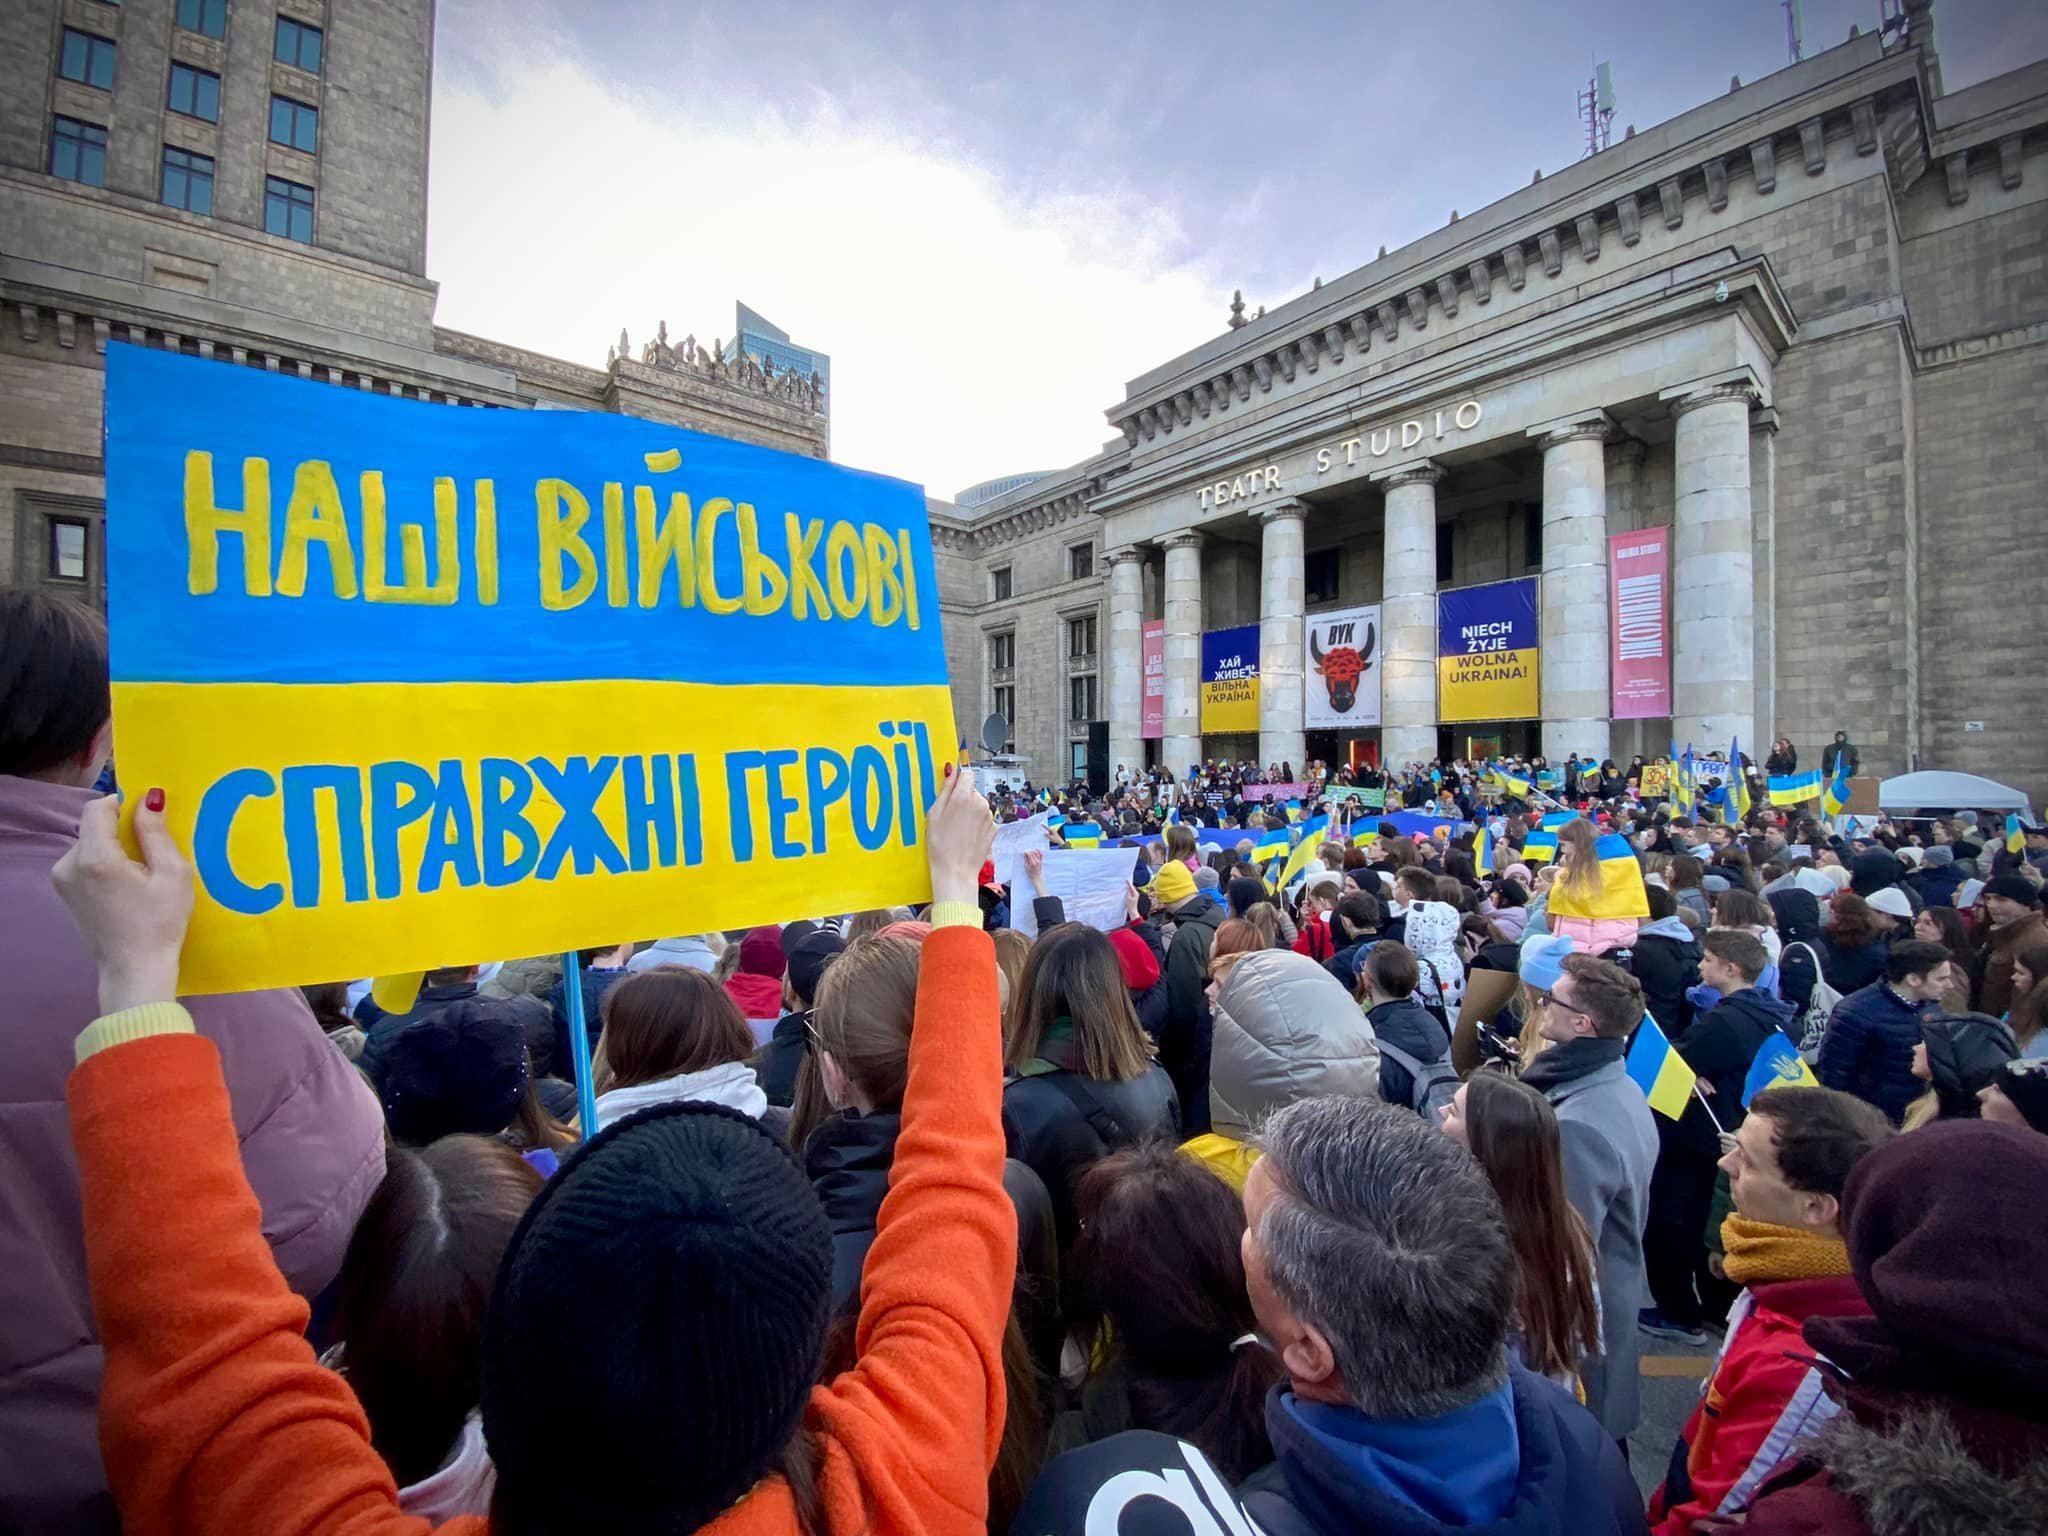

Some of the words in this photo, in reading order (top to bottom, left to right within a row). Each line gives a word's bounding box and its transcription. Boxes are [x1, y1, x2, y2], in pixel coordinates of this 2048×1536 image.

[1196, 465, 1282, 511] TEATR
[1316, 400, 1484, 474] STUDIO
[184, 449, 498, 606] НАШІ
[535, 448, 922, 631] ВІЙСЬКОВІ
[1328, 622, 1356, 646] BYK
[1461, 620, 1512, 639] NIECH
[1467, 637, 1507, 654] ŻYJE
[1219, 655, 1241, 669] ХАЙ
[1457, 652, 1518, 668] WOLNA
[1214, 668, 1247, 681] ЖИВЕ
[1449, 665, 1528, 683] UKRAINA!
[1211, 680, 1249, 692] ВІЛЬНА
[1206, 691, 1255, 704] УКРАЇНА!
[193, 753, 703, 914] СПРАВЖНІ
